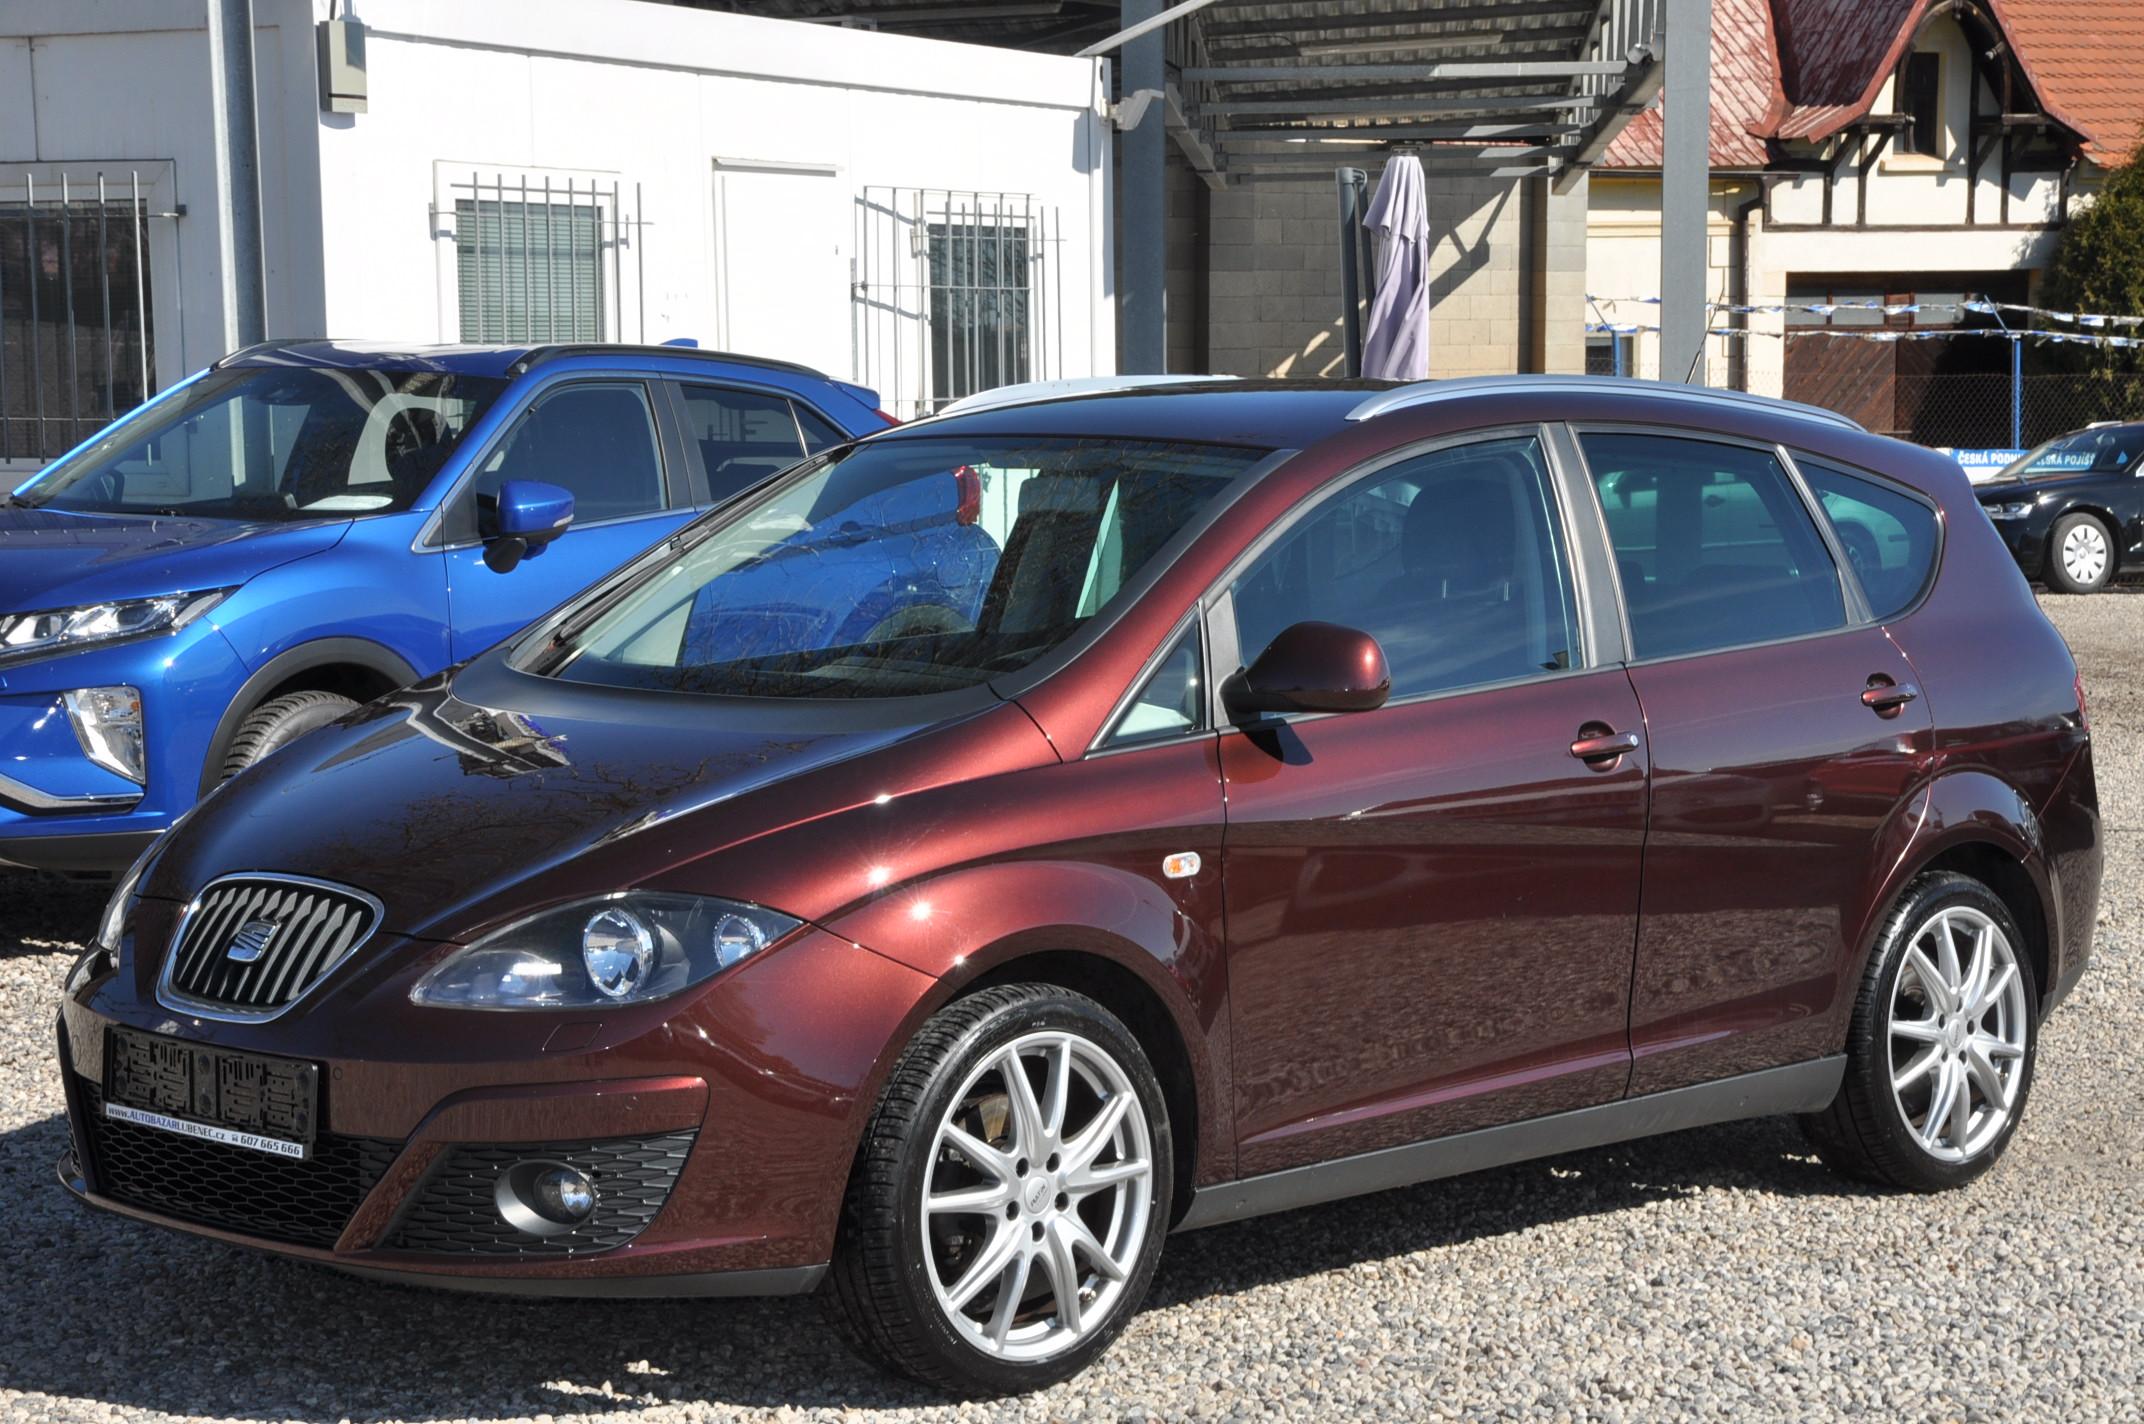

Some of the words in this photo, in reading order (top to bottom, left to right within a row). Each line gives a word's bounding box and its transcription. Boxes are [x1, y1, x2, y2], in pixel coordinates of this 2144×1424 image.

[1957, 450, 1989, 465] ČESKÁ
[240, 1134, 259, 1147] 607
[260, 1138, 279, 1152] 665
[280, 1142, 300, 1156] 666
